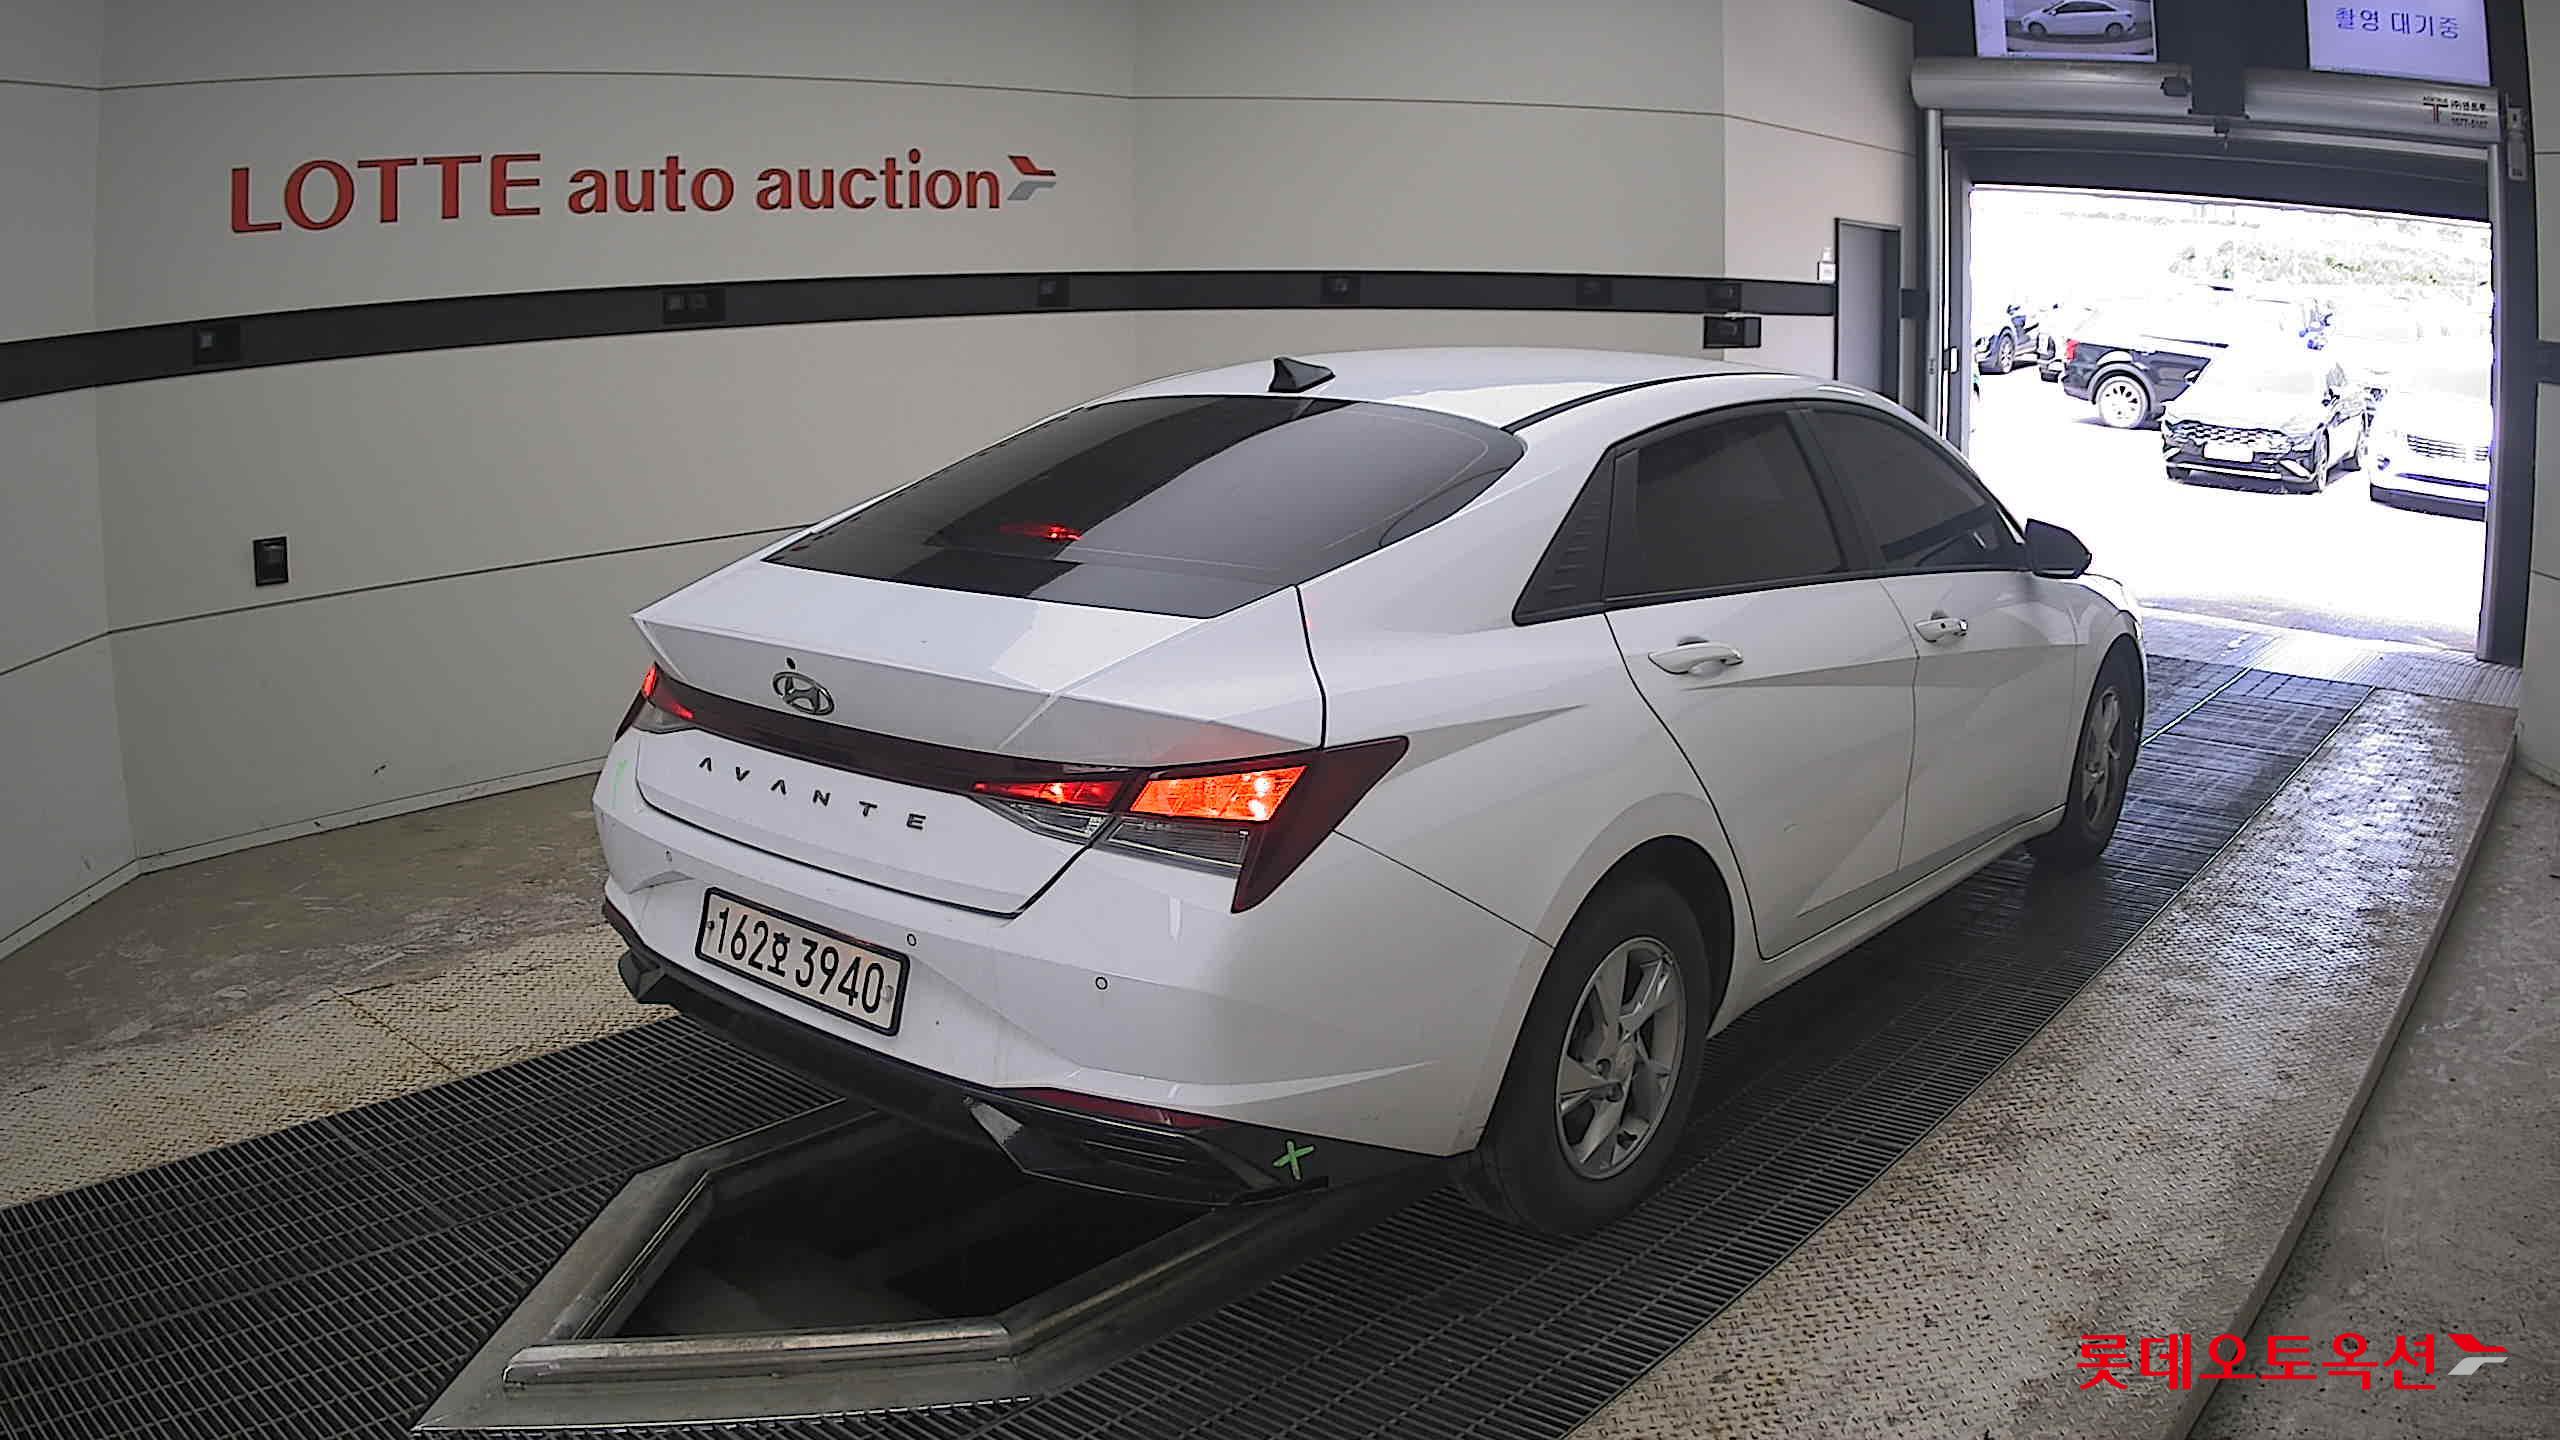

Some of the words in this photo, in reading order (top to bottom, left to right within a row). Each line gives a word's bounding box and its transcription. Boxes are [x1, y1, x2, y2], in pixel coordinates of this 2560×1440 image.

[2391, 12, 2460, 39] 대기중
[231, 153, 541, 233] LOTTE
[568, 156, 736, 214] auto
[756, 149, 1001, 211] auction
[699, 757, 927, 830] AVANTE
[794, 936, 886, 1014] 3940
